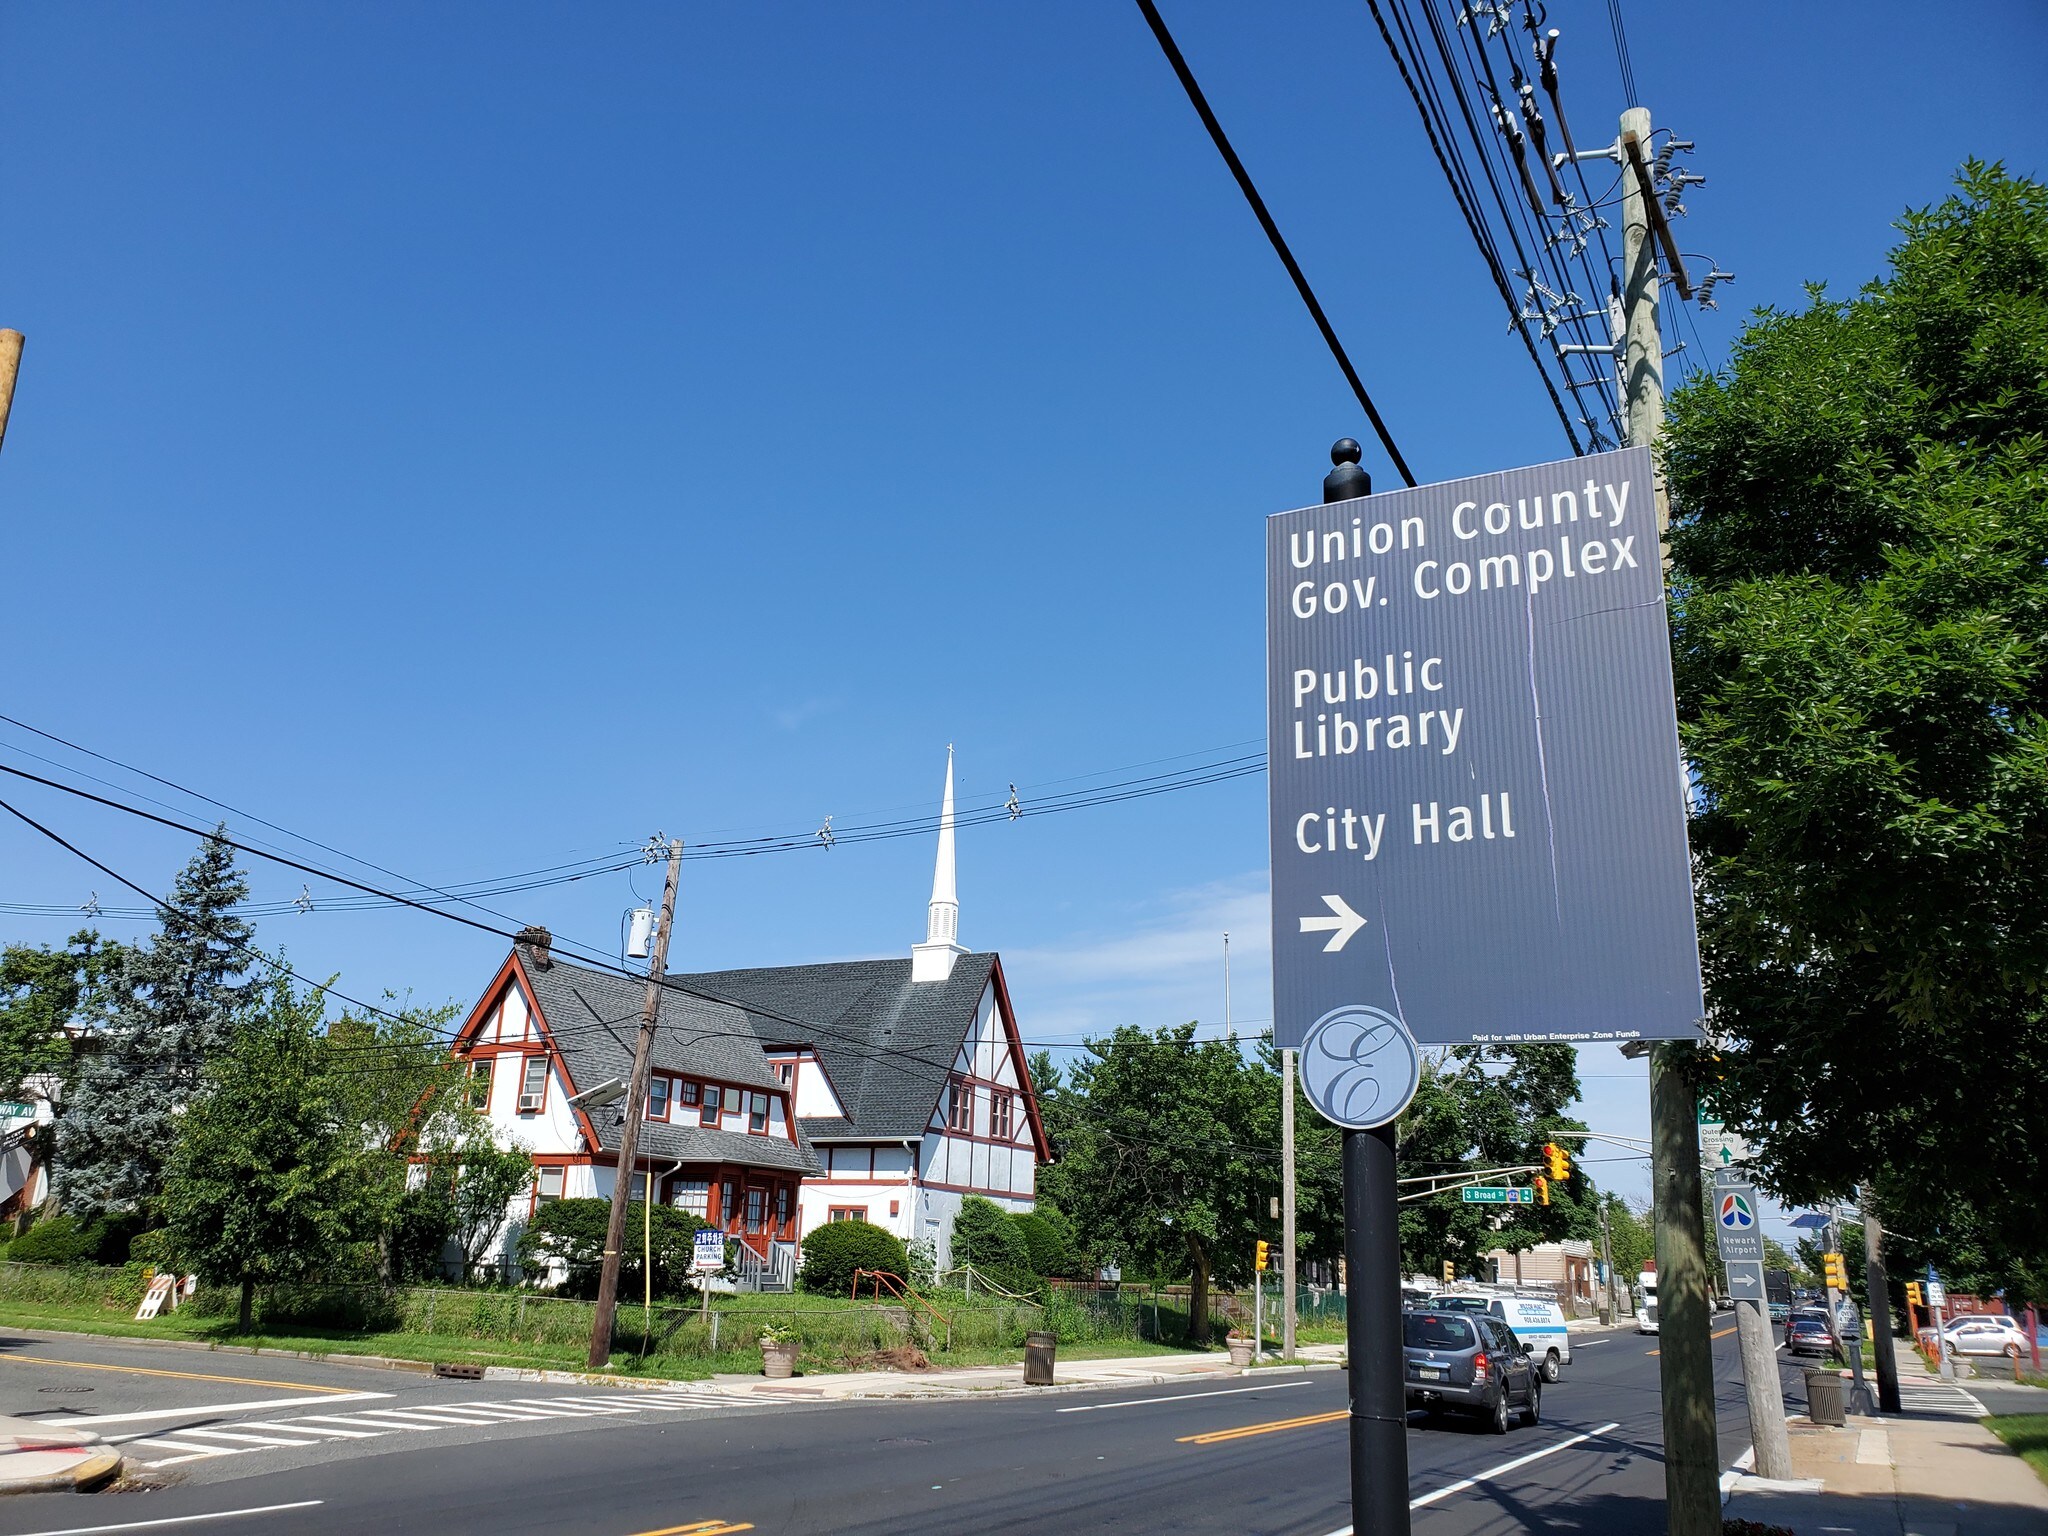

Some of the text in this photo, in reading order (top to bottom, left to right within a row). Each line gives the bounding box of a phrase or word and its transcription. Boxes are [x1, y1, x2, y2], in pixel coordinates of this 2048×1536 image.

[1290, 479, 1631, 570] Union County
[1291, 534, 1639, 619] Gov. Complex
[1294, 651, 1444, 708] Public
[1294, 708, 1464, 759] Library
[1296, 792, 1515, 861] City Hall
[1472, 1034, 1489, 1042] Paid
[1504, 1033, 1522, 1041] with
[1523, 1033, 1547, 1041] Urban
[1549, 1032, 1591, 1041] Enterprise
[1592, 1031, 1614, 1039] Zone
[1615, 1030, 1641, 1038] Funds
[20, 1106, 36, 1117] AV
[1703, 1135, 1734, 1143] Crossing
[1465, 1191, 1472, 1199] S
[1474, 1190, 1496, 1199] Broad
[1723, 1236, 1757, 1244] Newark
[1725, 1246, 1758, 1256] Airport
